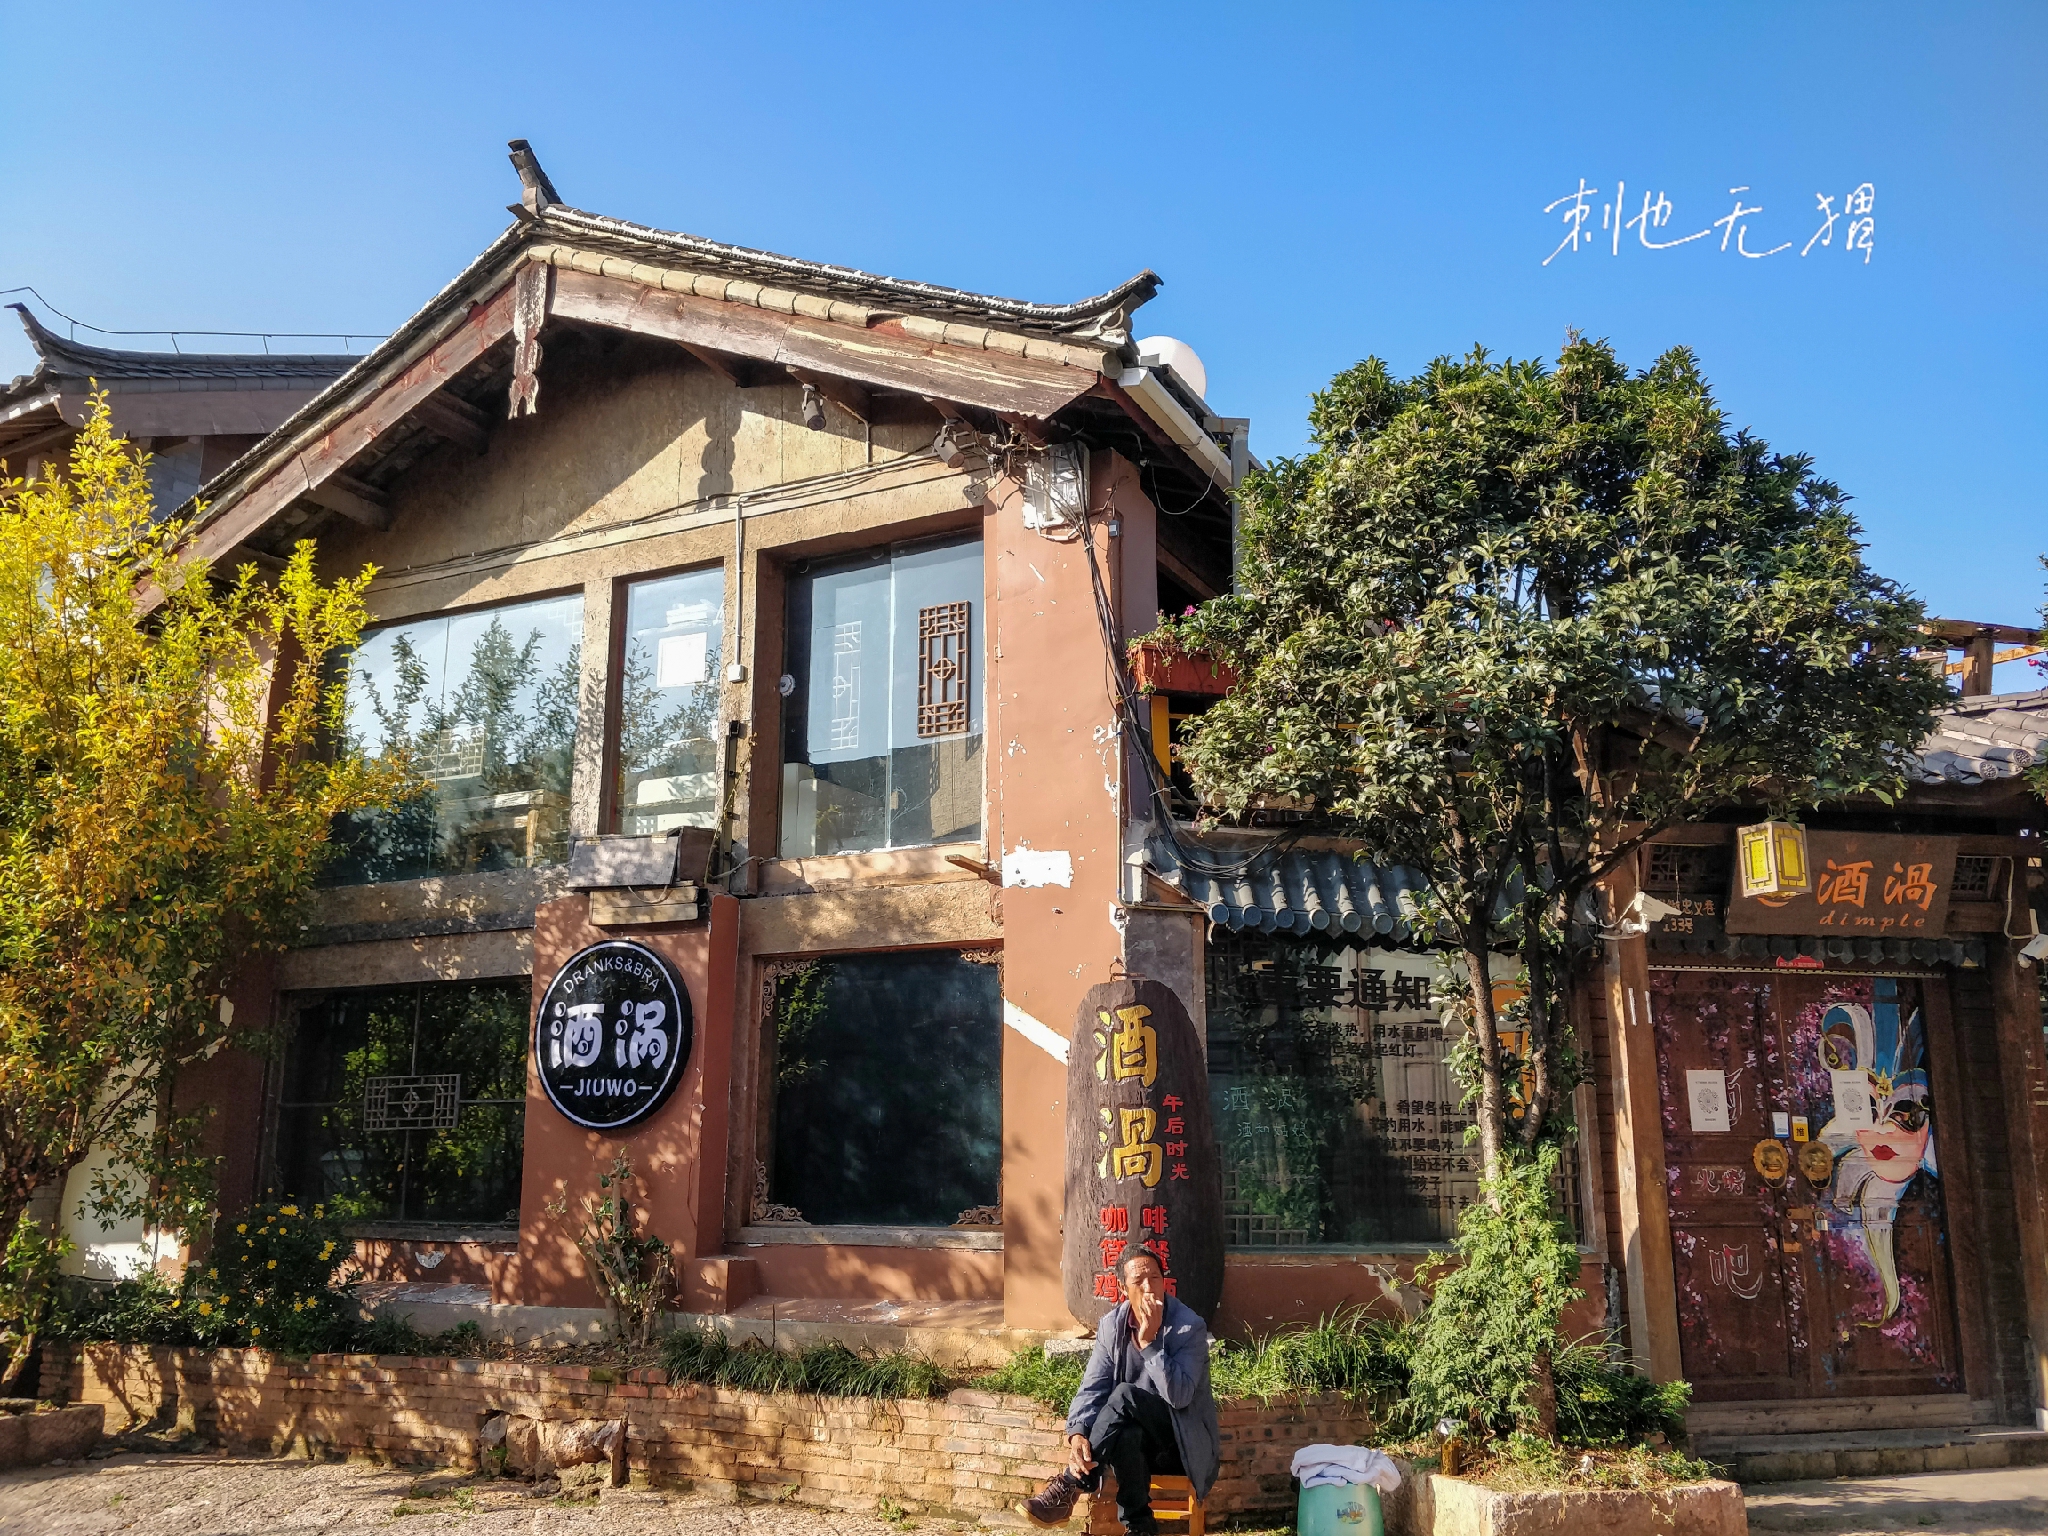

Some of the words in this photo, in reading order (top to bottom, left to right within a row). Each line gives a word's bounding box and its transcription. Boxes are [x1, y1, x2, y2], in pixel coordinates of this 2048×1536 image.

[1659, 898, 1716, 916] 忠义巷
[1818, 910, 1926, 933] dimple
[562, 956, 660, 994] DRANKS&BRA
[1162, 1094, 1191, 1181] 午后时光
[1100, 1203, 1169, 1234] 咖啡
